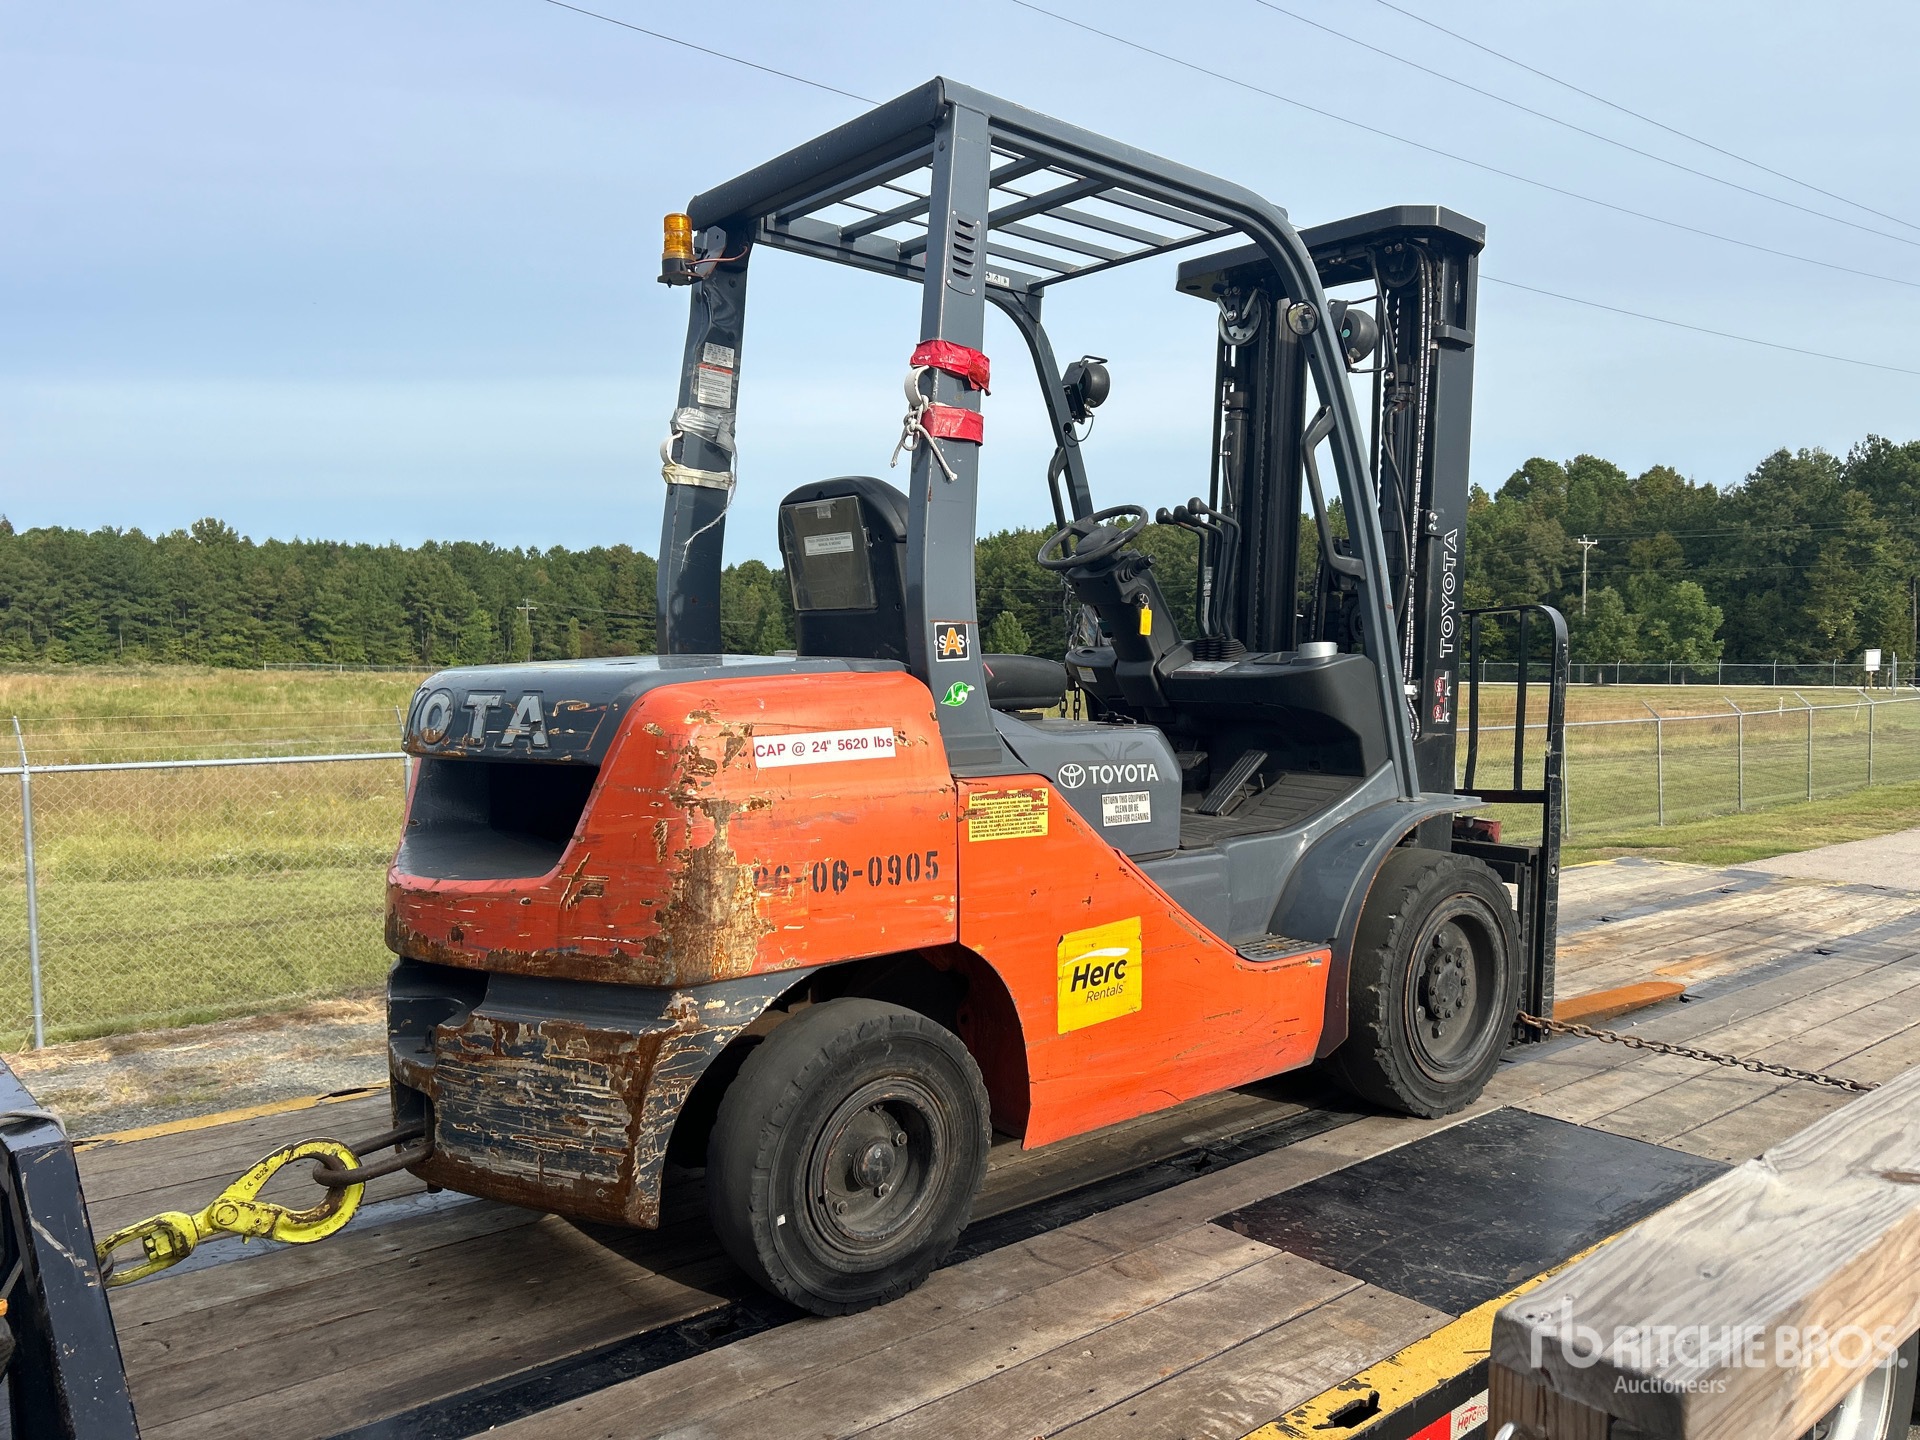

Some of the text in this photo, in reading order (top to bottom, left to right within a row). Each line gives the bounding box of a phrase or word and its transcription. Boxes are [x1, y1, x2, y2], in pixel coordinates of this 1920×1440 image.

[1440, 529, 1457, 658] TOYOTA
[412, 688, 548, 749] OTA
[755, 743, 786, 758] CAP
[792, 742, 805, 756] @
[838, 738, 868, 751] 5620
[874, 736, 893, 748] lbs
[1089, 764, 1159, 784] TOYOTA
[1103, 796, 1118, 804] RETURN
[1119, 795, 1127, 803] THIS
[1115, 805, 1127, 813] CLEAN
[1105, 815, 1122, 824] CHARGED
[1131, 813, 1149, 822] CLEANING
[1071, 960, 1127, 992] Herc
[1086, 983, 1123, 1003] Rentals
